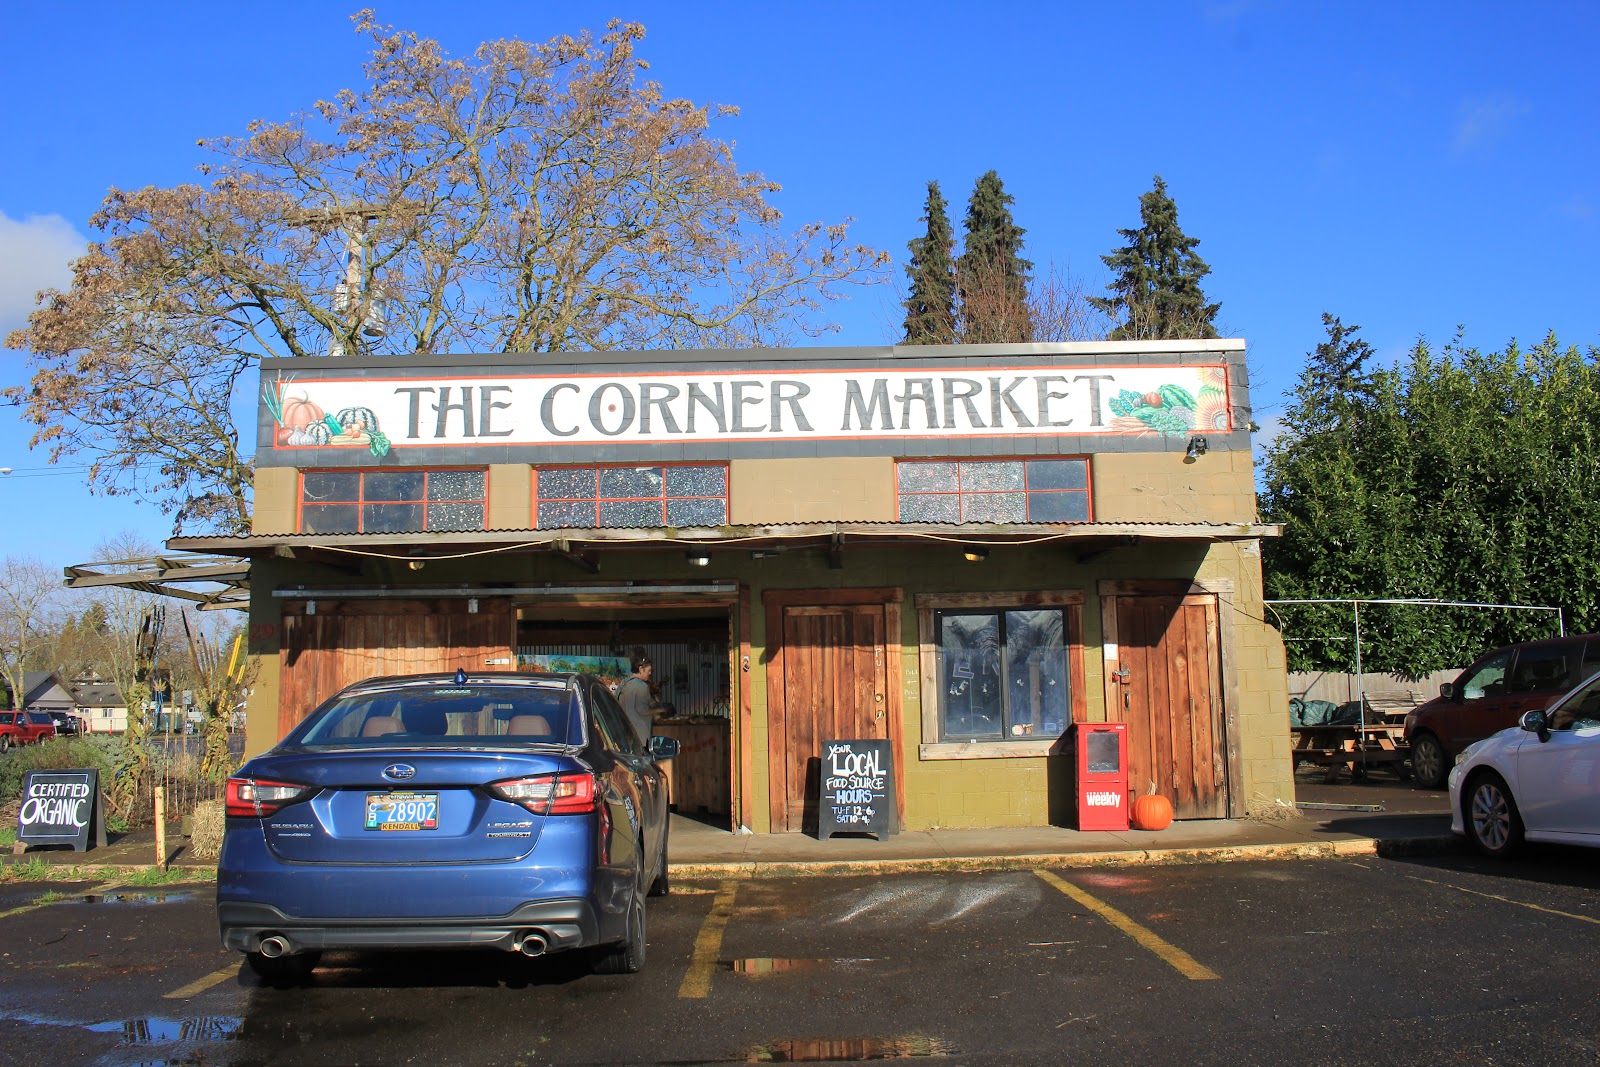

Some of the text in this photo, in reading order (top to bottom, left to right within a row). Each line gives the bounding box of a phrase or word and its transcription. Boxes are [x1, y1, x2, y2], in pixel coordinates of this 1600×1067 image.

[394, 374, 1115, 439] THE CORNER MARKET
[827, 744, 852, 760] YOUR
[832, 749, 886, 778] LOCAL
[29, 783, 90, 797] CERTIFIED
[826, 775, 885, 790] FOOD SOURCE
[836, 789, 872, 804] HOURS
[1086, 791, 1121, 808] weekly
[20, 798, 88, 827] ORGANIC
[387, 802, 436, 822] 28902
[836, 814, 850, 823] SAT
